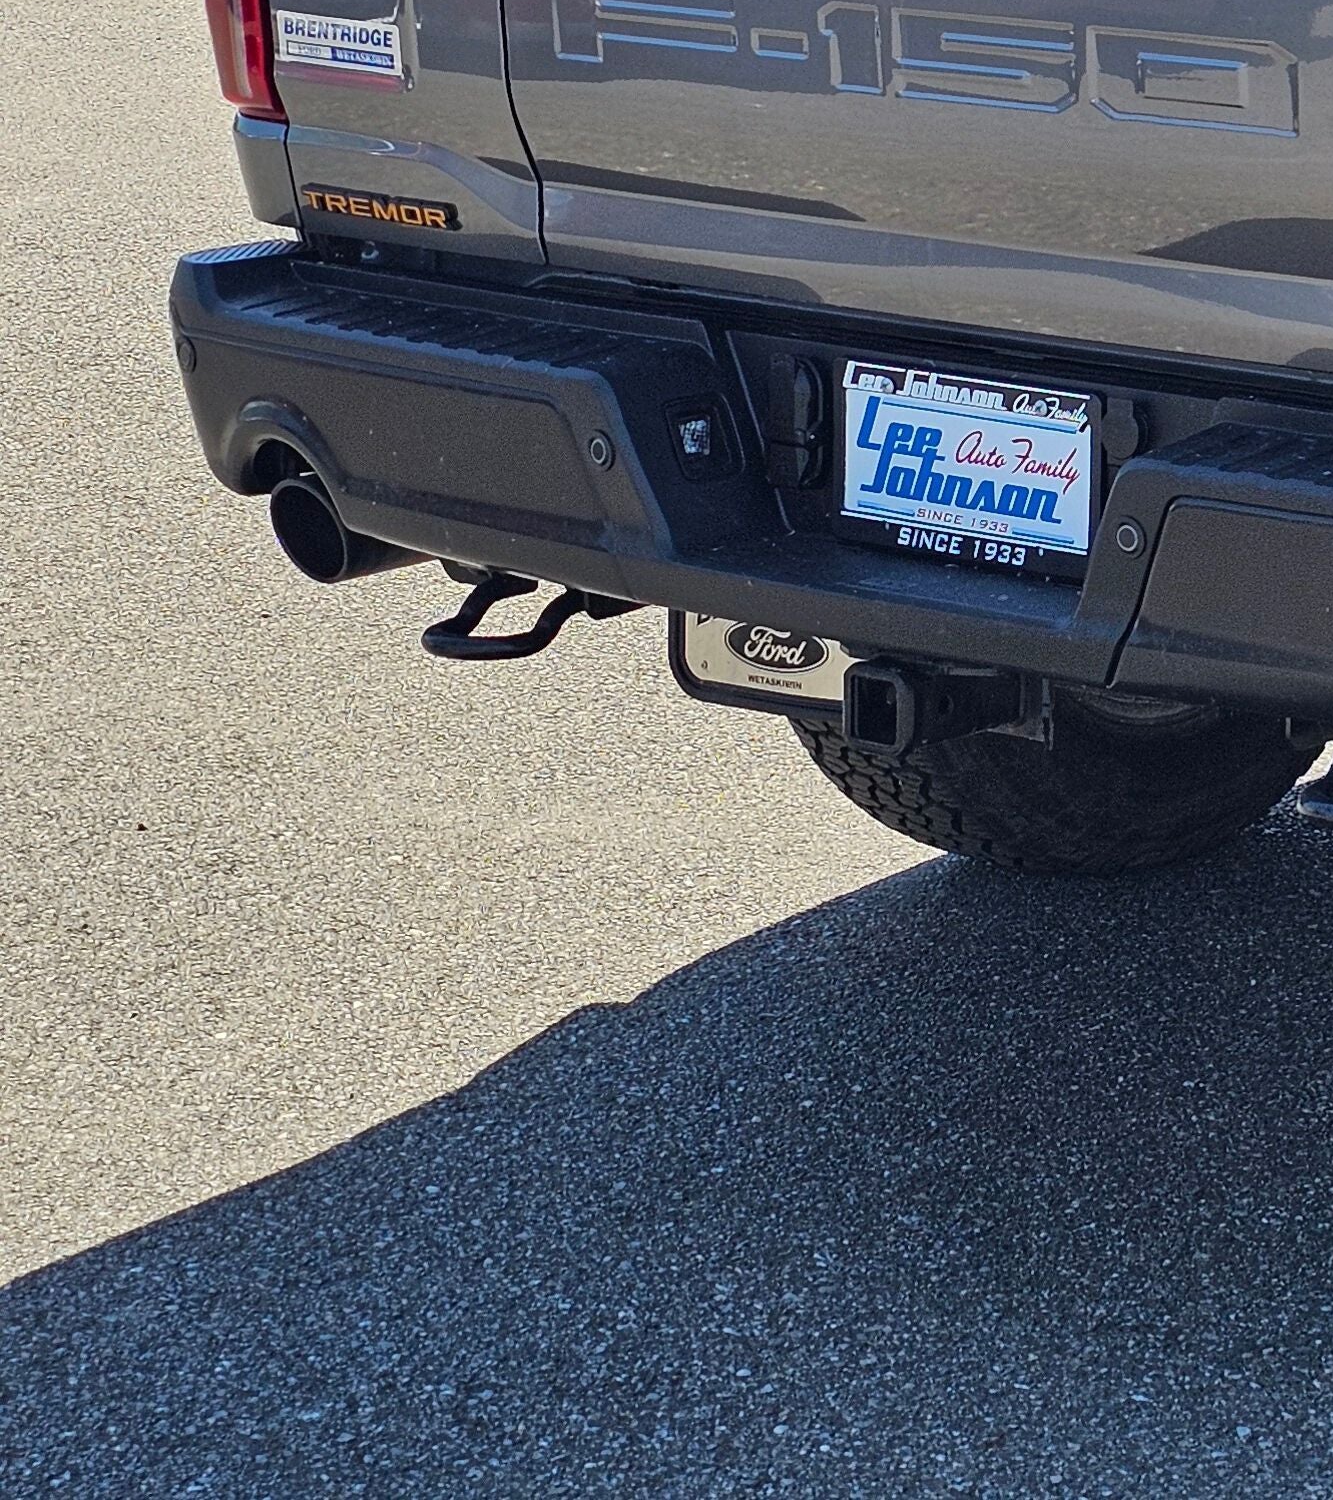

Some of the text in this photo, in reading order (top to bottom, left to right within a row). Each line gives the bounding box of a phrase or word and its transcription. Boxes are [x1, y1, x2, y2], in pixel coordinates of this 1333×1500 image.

[283, 16, 394, 49] BRENTRIDGE
[302, 189, 447, 229] TREMOR
[896, 368, 1008, 411] Johnson
[1043, 396, 1089, 433] Family
[856, 395, 943, 458] Lee
[955, 430, 1082, 496] Auto Family
[859, 448, 1062, 525] Johnson
[916, 507, 1010, 534] SINCE 1933
[897, 527, 1027, 566] SINCE 1933
[743, 625, 808, 665] Ford
